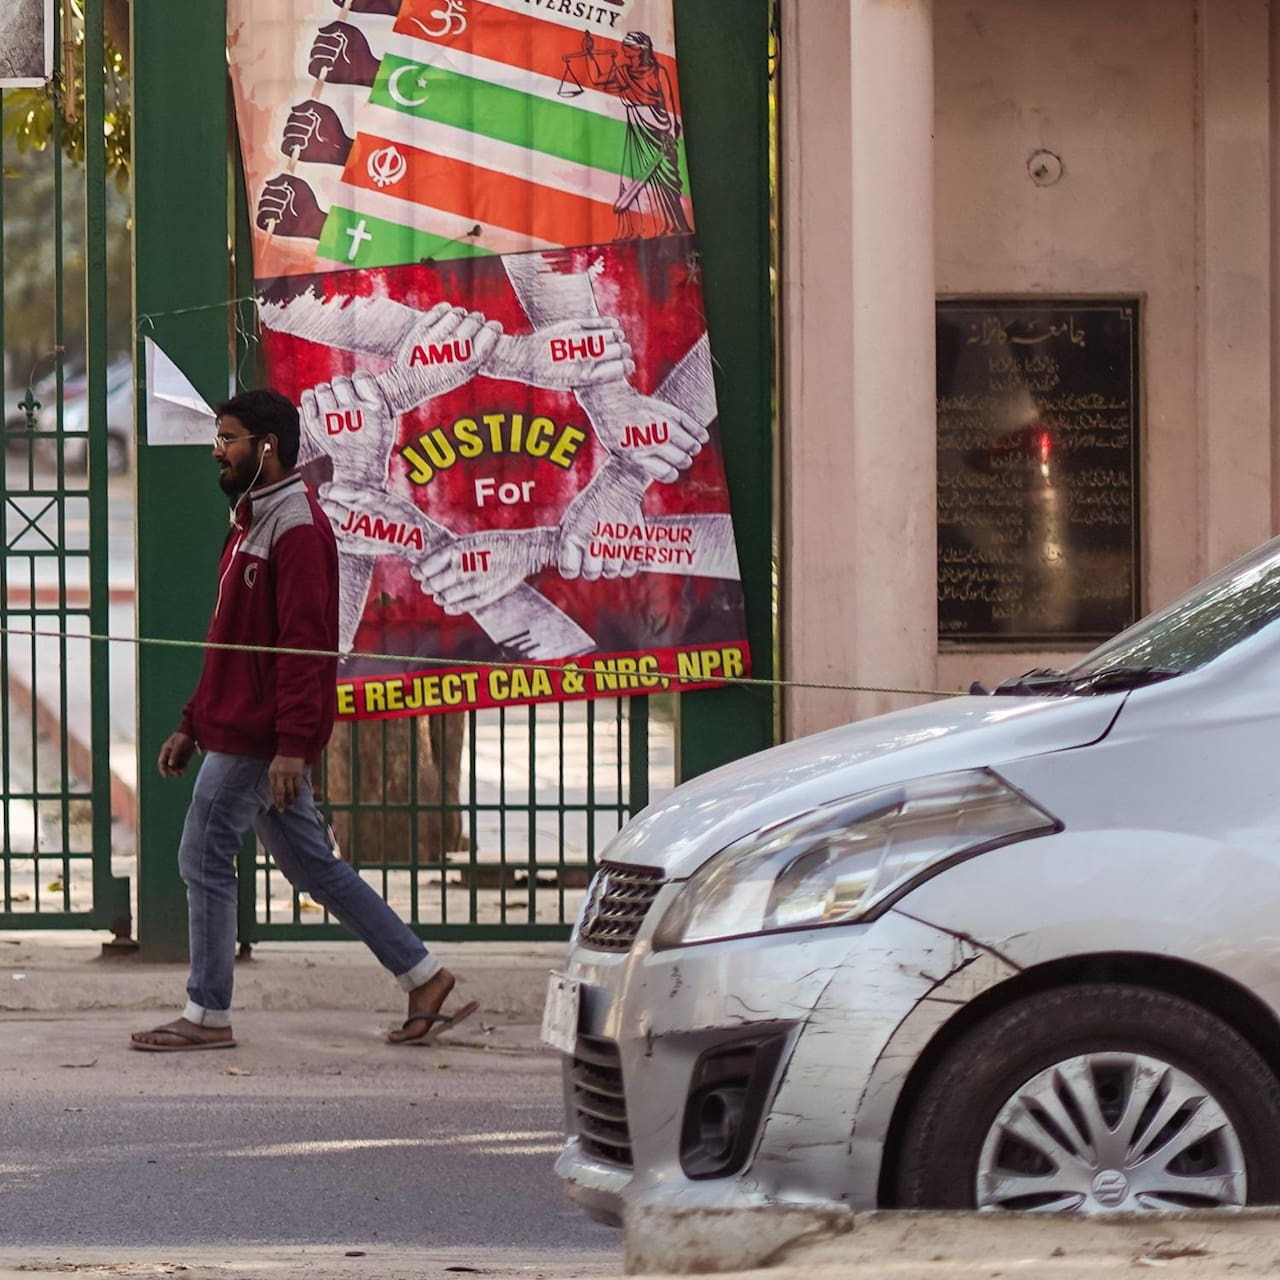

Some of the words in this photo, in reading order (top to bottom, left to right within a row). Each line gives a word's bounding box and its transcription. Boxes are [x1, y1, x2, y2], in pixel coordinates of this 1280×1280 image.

[409, 339, 472, 368] AMU
[550, 335, 606, 362] BHU
[325, 410, 363, 435] DU
[619, 422, 669, 448] JNU
[402, 414, 586, 485] JUSTICE
[473, 478, 536, 507] For
[340, 510, 424, 550] JAMIA
[591, 521, 693, 544] JADAVPUR
[460, 551, 491, 573] IIT
[589, 542, 697, 566] UNIVERSITY
[337, 683, 355, 715] E
[364, 672, 479, 713] REJECT
[488, 667, 553, 701] CAA
[561, 663, 585, 695] &
[593, 655, 669, 692] NRC,
[676, 647, 743, 684] NPR
